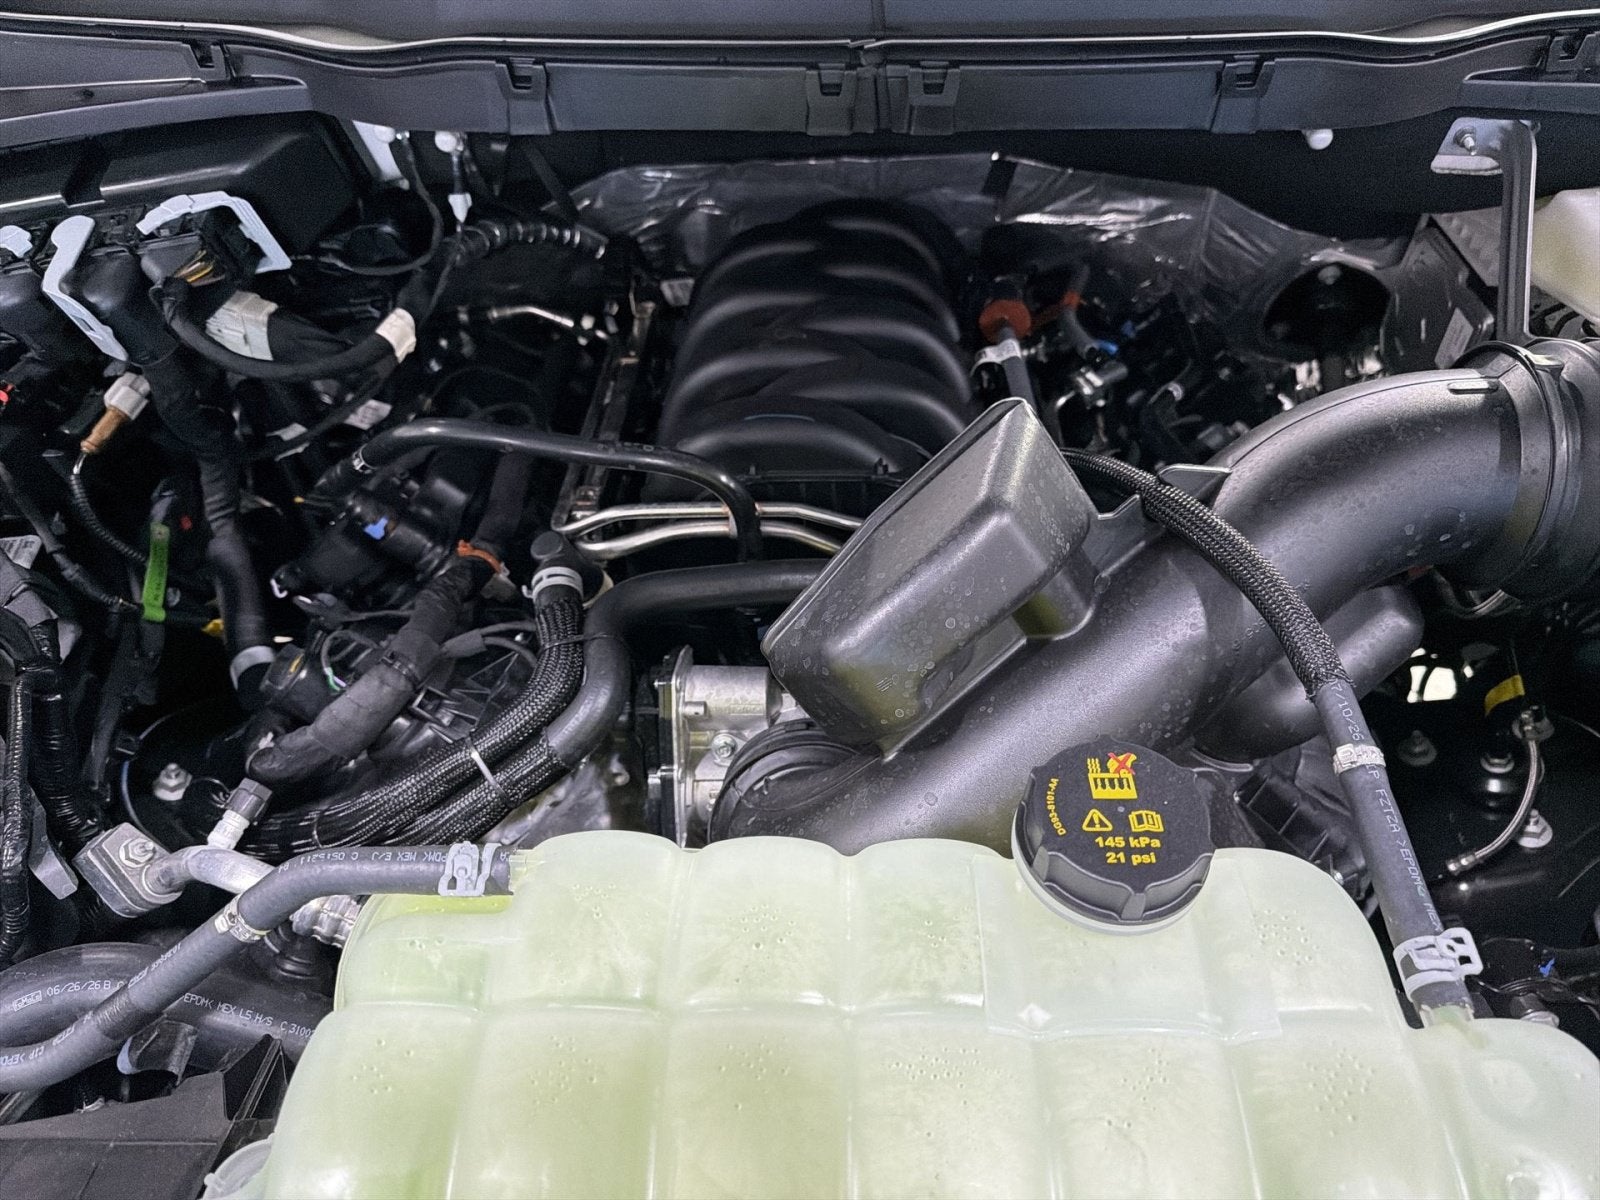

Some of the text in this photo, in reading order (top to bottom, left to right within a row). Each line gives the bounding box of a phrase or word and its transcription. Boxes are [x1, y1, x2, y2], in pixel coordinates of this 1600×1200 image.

[1329, 682, 1365, 741] 7/10/26
[1095, 836, 1161, 848] 145 kPa
[397, 851, 417, 861] MEX
[1105, 852, 1157, 866] 21 psi
[46, 980, 101, 997] 06/26/26
[216, 1001, 237, 1016] MEX
[0, 1055, 24, 1066] >EPD
